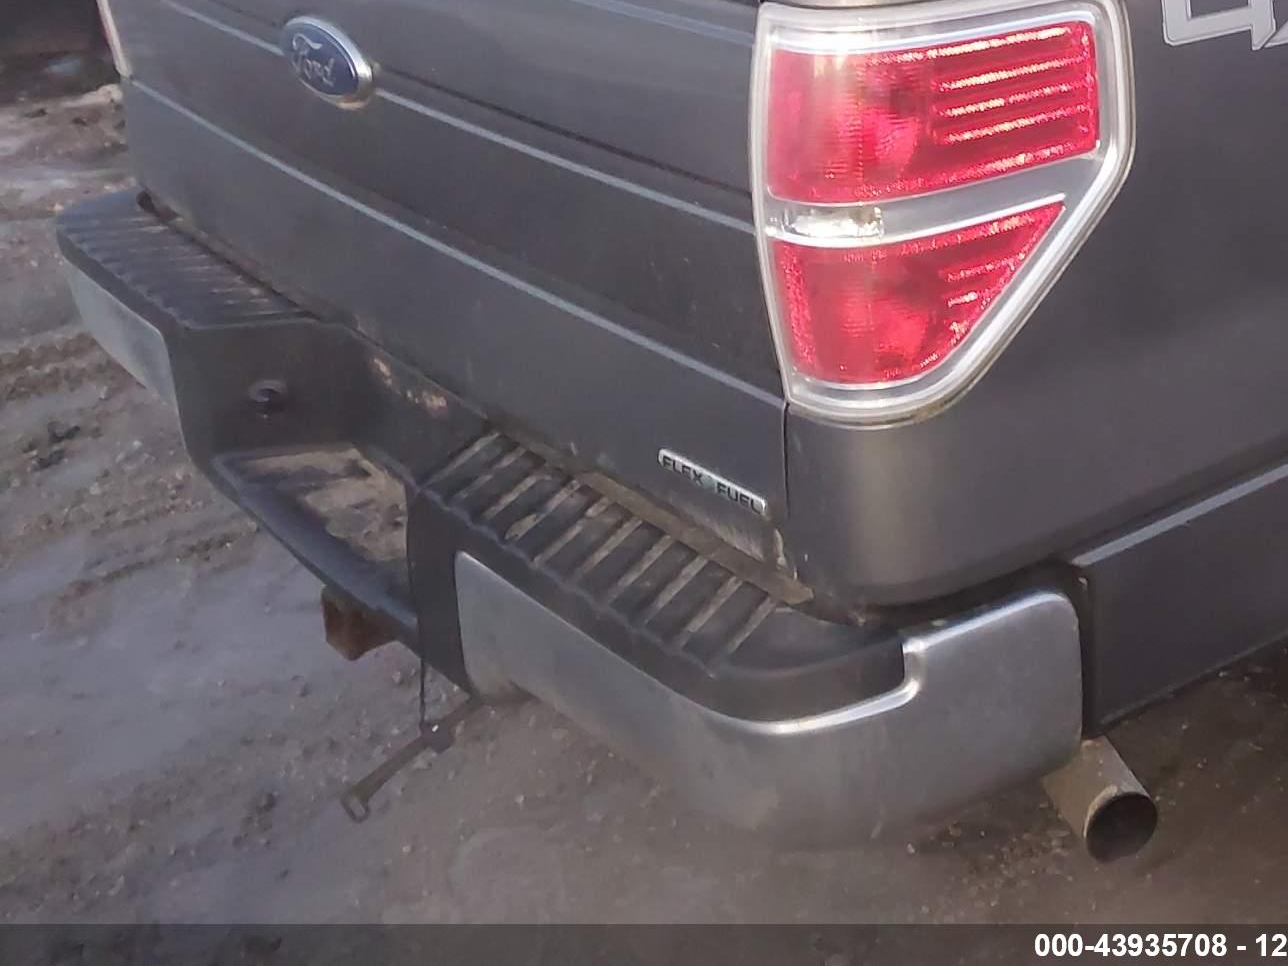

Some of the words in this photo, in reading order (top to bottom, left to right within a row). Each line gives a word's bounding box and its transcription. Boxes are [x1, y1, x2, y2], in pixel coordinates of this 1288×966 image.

[291, 32, 336, 88] Ford
[662, 454, 704, 485] FLEX
[716, 482, 762, 515] FUEL
